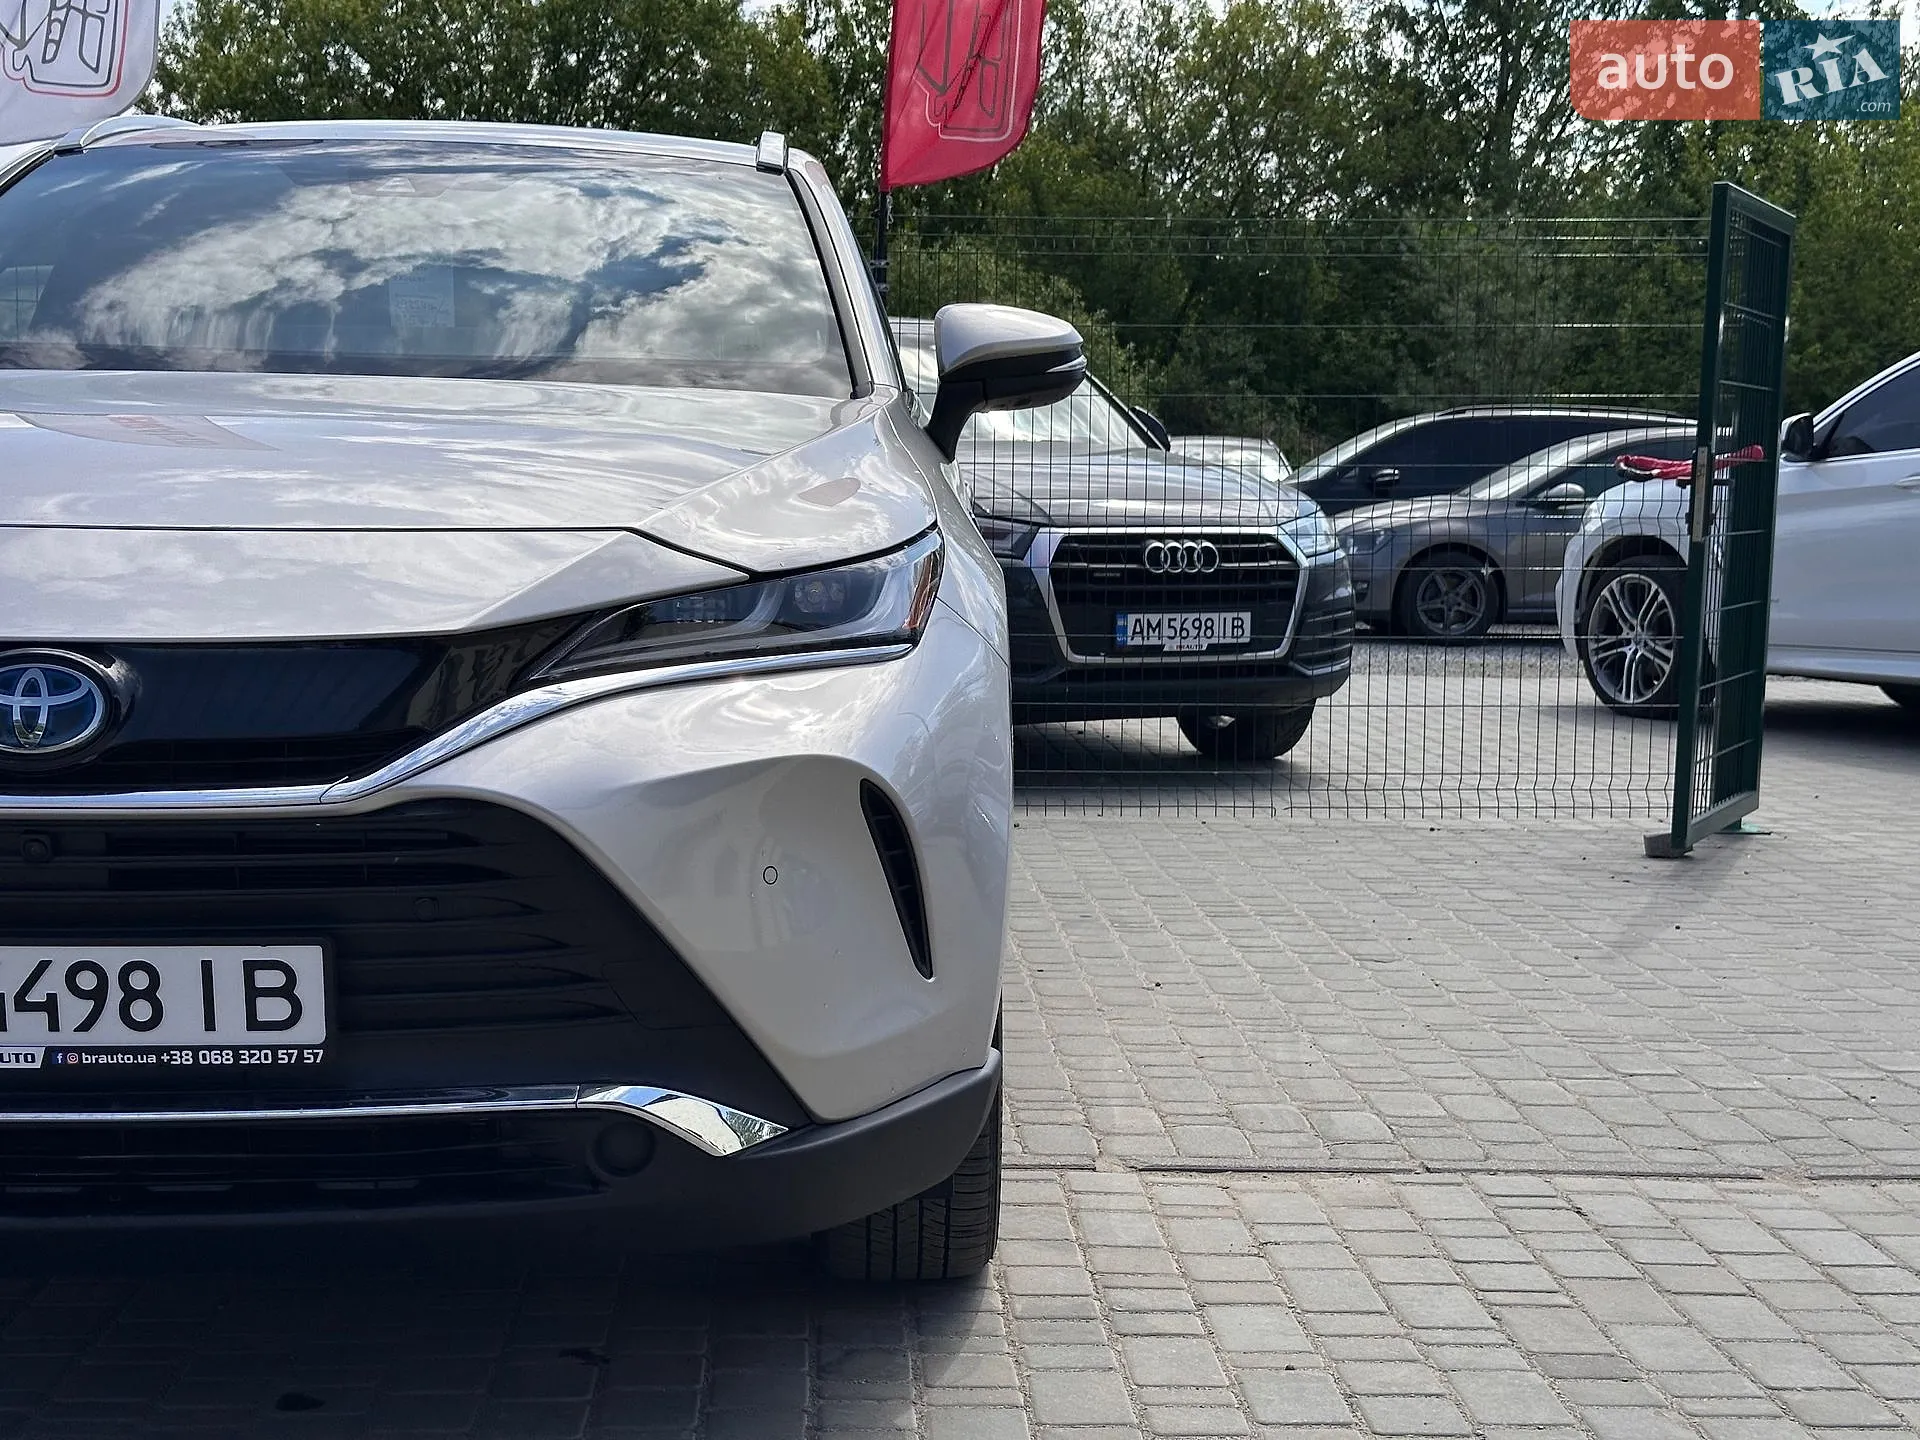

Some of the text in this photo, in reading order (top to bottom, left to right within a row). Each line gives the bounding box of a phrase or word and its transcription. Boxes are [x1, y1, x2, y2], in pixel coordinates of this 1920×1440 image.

[1130, 616, 1245, 641] AM 5698 IB
[0, 959, 303, 1032] 498 IB
[0, 1052, 36, 1064] UTO
[82, 1052, 157, 1064] brauto.ua
[161, 1050, 193, 1065] +38
[198, 1050, 234, 1064] 068
[238, 1049, 272, 1064] 320
[277, 1049, 298, 1064] 57
[303, 1049, 324, 1063] 57
